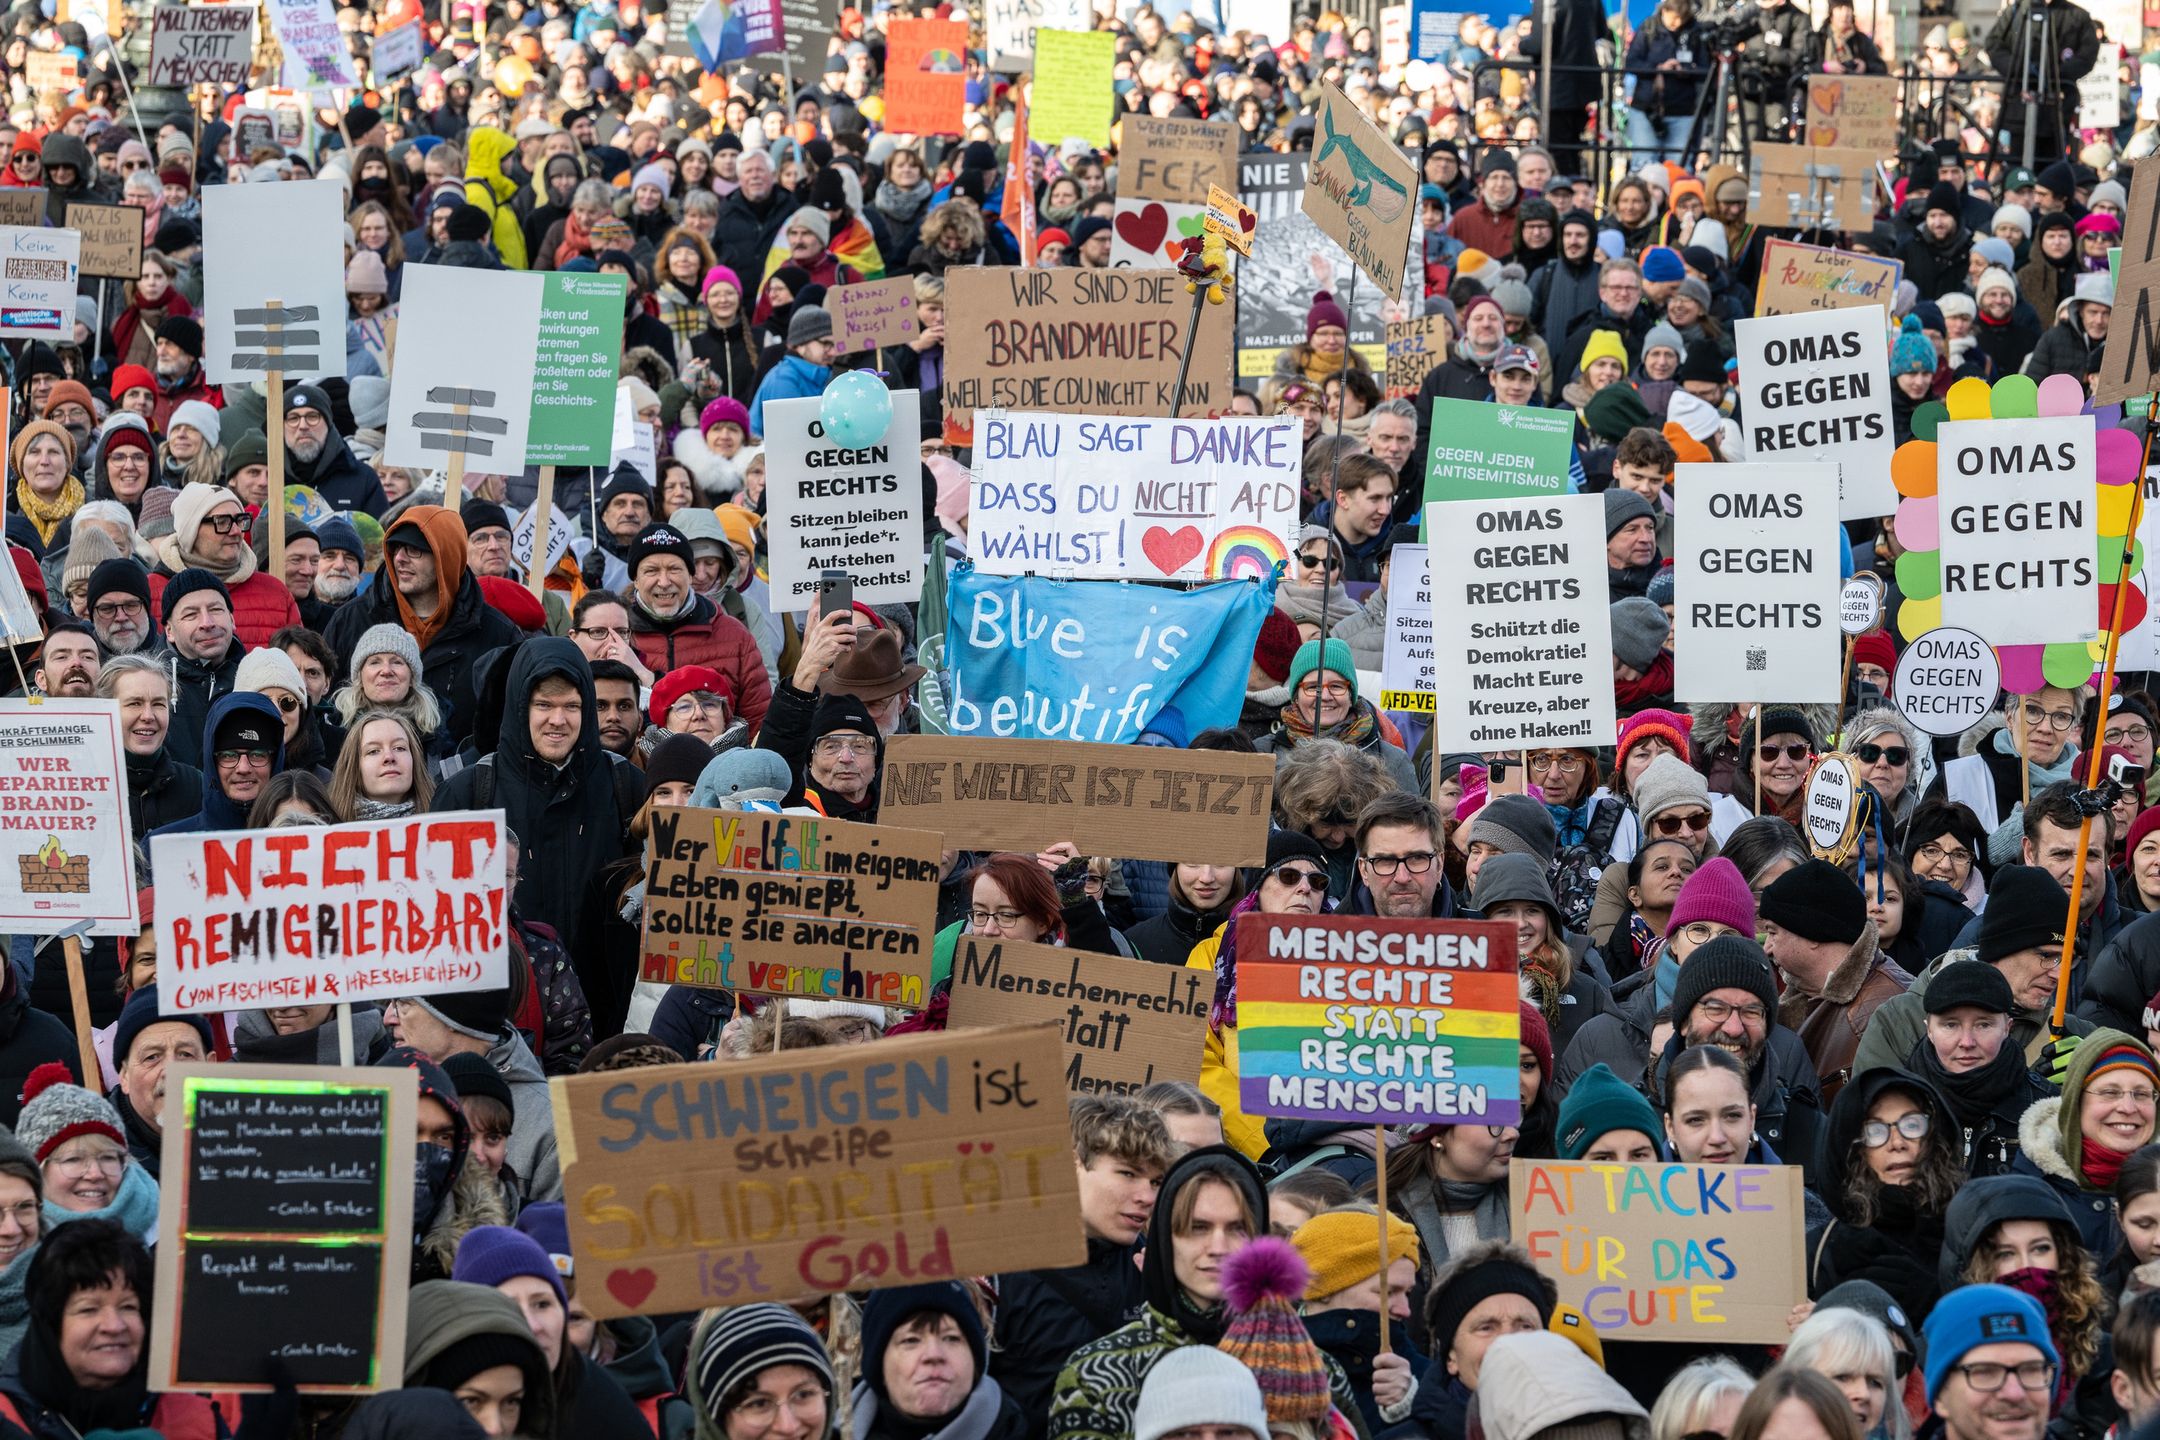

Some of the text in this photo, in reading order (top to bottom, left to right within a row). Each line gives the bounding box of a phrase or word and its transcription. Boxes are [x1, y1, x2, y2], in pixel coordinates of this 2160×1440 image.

[175, 34, 235, 59] STATT
[154, 56, 252, 83] MENSCHEN
[1135, 158, 1217, 193] FCK
[1243, 164, 1290, 186] NIE
[72, 208, 121, 227] NAZIS
[1347, 212, 1371, 240] GEGEN
[15, 233, 56, 253] Keine
[1814, 250, 1853, 267] Lieber
[8, 283, 48, 302] Keine
[1011, 271, 1175, 307] WIR SIND DIE
[1811, 293, 1838, 310] als
[568, 310, 589, 320] und
[538, 324, 599, 337] nwirkungen
[1386, 316, 1434, 342] FRITZE
[985, 319, 1182, 367] BRANDMAUER
[1387, 336, 1427, 356] MERZ
[1763, 331, 1861, 367] OMAS
[554, 352, 608, 365] fragen Sie
[1387, 350, 1437, 373] FISCHT
[587, 367, 612, 378] oder
[552, 380, 568, 391] Sie
[947, 379, 983, 409] WEIL
[992, 377, 1016, 406] ES
[1015, 377, 1049, 406] DIE
[1054, 380, 1095, 406] CDU
[1096, 380, 1148, 406] NICHT
[1760, 372, 1871, 409] GEGEN
[535, 394, 597, 406] Geschichts-
[1515, 420, 1568, 433] Friedensdienste
[1754, 412, 1884, 453] RECHTS
[805, 445, 888, 468] GEGEN
[986, 422, 1297, 472] BLAU SAGT DANKE,
[1434, 447, 1535, 470] GEGEN JEDEN
[1957, 442, 2076, 476] OMAS
[798, 474, 898, 498] RECHTS
[1432, 466, 1560, 489] ANTISEMITISMUS
[979, 480, 1296, 523] DASS DU NICHT AfD
[1709, 493, 1803, 519] OMAS
[790, 508, 908, 528] Sitzen bleiben
[1476, 508, 1563, 534] OMAS
[1950, 500, 2083, 534] GEGEN
[800, 535, 841, 548] kann
[981, 519, 1126, 567] WÄHLST!
[807, 552, 895, 569] Aufstehen
[1474, 543, 1569, 569] GEGEN
[1699, 548, 1813, 574] GEGEN
[848, 571, 910, 588] Rechts!
[1945, 557, 2092, 593] RECHTS
[1466, 578, 1581, 605] RECHTS
[1844, 590, 1869, 600] OMAS
[1692, 603, 1822, 629] RECHTS
[1842, 601, 1870, 611] GEGEN
[968, 589, 1188, 671] Blue is
[1470, 618, 1580, 639] Schützt die
[1467, 643, 1587, 664] Demokratie!
[1917, 640, 1980, 660] OMAS
[1473, 669, 1583, 690] Macht Eure
[1910, 668, 1982, 688] GEGEN
[1469, 696, 1590, 716] Kreuze, aber
[1905, 695, 1985, 715] RECHTS
[0, 725, 94, 736] HKRÄFTEMANGEL
[17, 736, 84, 747] SCHLIMMER:
[1470, 719, 1592, 741] ohne Haken!!
[17, 757, 71, 772] WER
[0, 776, 110, 791] EPARIERT
[884, 762, 1273, 816] NIE WIEDER IST JETZT
[1820, 769, 1844, 786] OMAS
[3, 796, 93, 811] BRAND-
[1814, 793, 1842, 811] GEGEN
[2, 816, 97, 830] MAUER?
[1809, 815, 1841, 834] RECHTS
[203, 821, 497, 903] NICHT
[651, 811, 940, 890] Wer Vielfalt im eigenen
[647, 860, 739, 900] Leben
[172, 887, 505, 973] REMIGRIERBAR!
[649, 901, 920, 955] sollte sie anderen
[1268, 926, 1489, 969] MENSCHEN
[323, 973, 340, 995] &
[643, 940, 923, 1005] nicht verwehren
[961, 941, 1208, 1018] Menschenrechte
[1300, 965, 1454, 1005] RECHTE
[1323, 1005, 1445, 1043] STATT
[1300, 1038, 1456, 1079] RECHTE
[599, 1055, 1039, 1153] SCHWEIGEN ist
[1267, 1073, 1488, 1116] MENSCHEN
[236, 1122, 293, 1138] Menschen
[734, 1126, 893, 1172] scheiße
[225, 1165, 249, 1179] sind
[252, 1166, 271, 1179] die
[581, 1142, 1064, 1262] SOLIDARITÄT
[1524, 1165, 1775, 1216] ATTACKE
[698, 1226, 955, 1298] ist Gold
[1527, 1225, 1737, 1282] FÜR DAS
[201, 1254, 257, 1277] Respekt
[268, 1254, 286, 1273] ist
[238, 1280, 289, 1296] Immer.
[1582, 1285, 1727, 1329] GUTE
